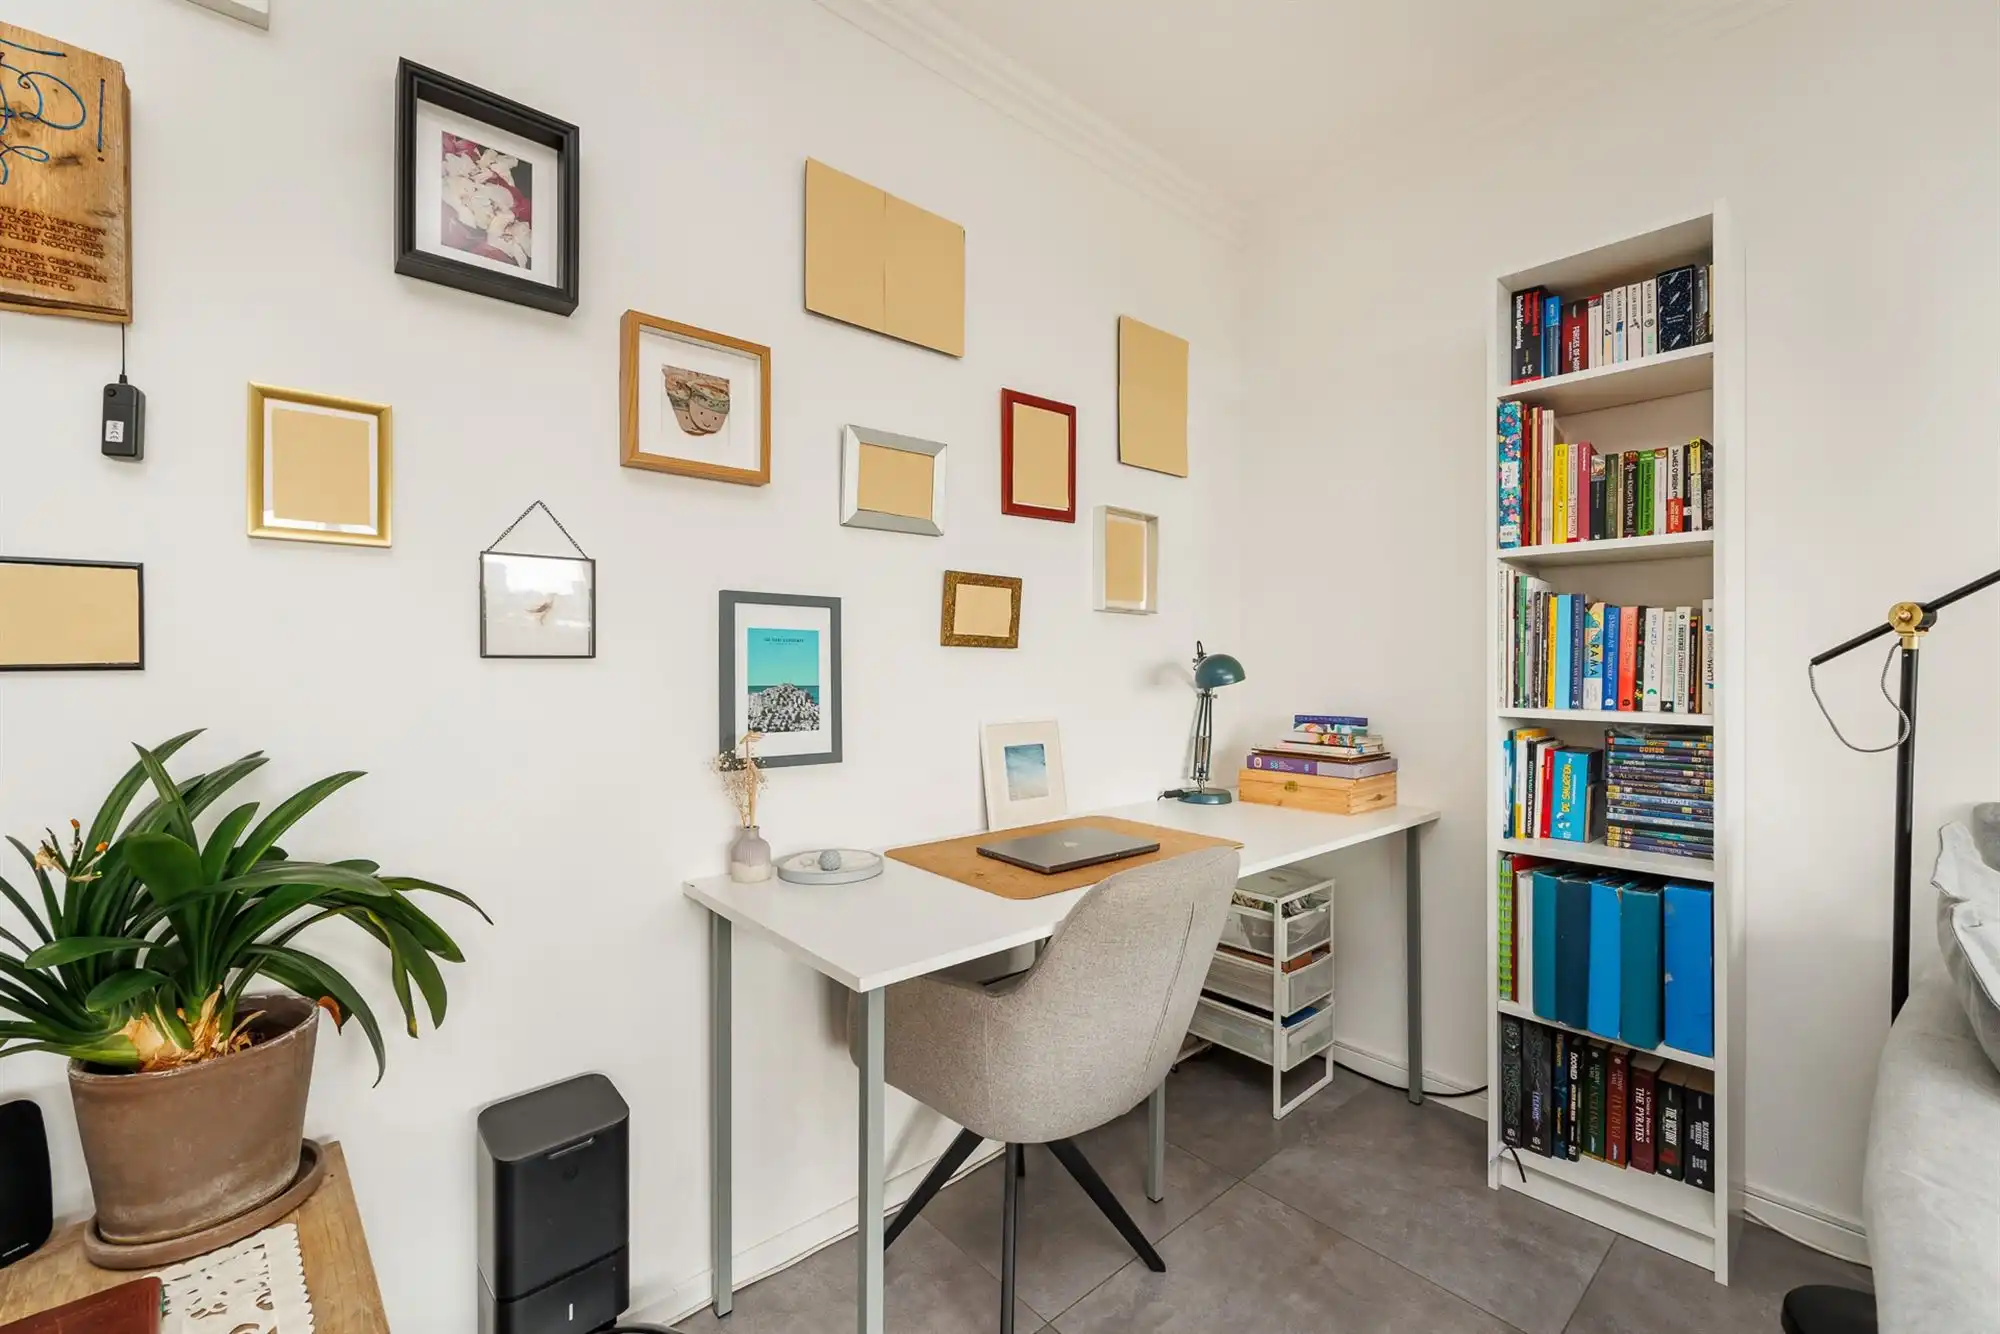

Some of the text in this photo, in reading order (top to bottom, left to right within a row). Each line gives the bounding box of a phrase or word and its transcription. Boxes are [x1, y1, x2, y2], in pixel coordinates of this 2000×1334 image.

[8, 216, 31, 226] ONS
[48, 216, 106, 236] VERKOREN
[0, 223, 17, 232] IJN
[44, 232, 104, 251] GEZWOREN
[8, 232, 38, 243] CLUB
[42, 239, 76, 253] NOOIT
[0, 246, 44, 261] DENTEN
[48, 256, 97, 273] GEBOREN
[11, 256, 47, 270] NOOIT
[51, 266, 108, 284] VERLOREN
[28, 268, 69, 282] GEREED
[33, 278, 57, 288] MET
[1626, 503, 1634, 525] TEMPLAR
[1635, 1087, 1644, 1143] THE PYRATES
[1665, 1107, 1677, 1146] THE VICTORY
